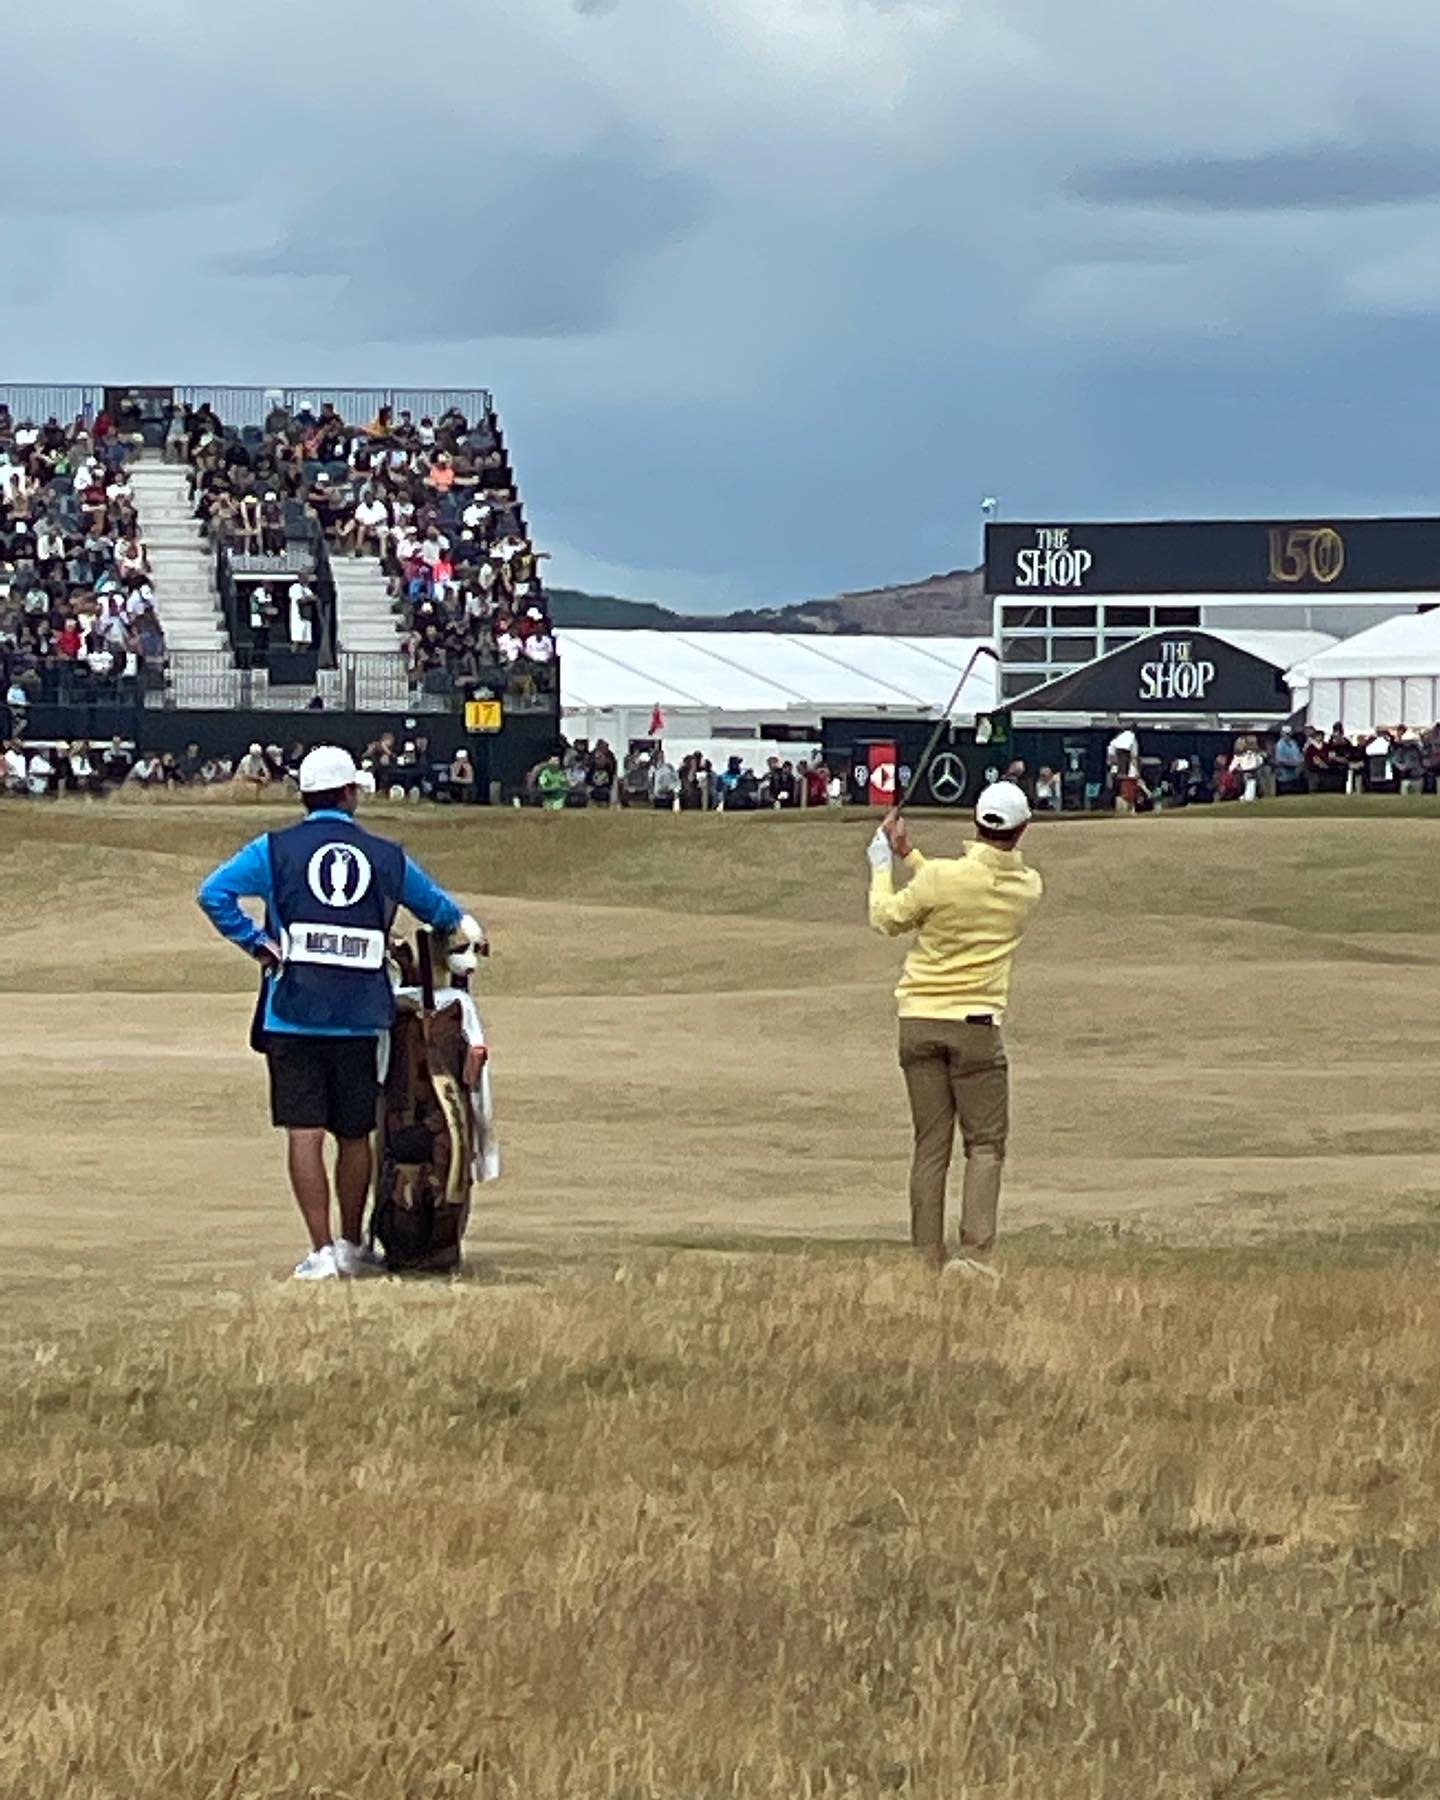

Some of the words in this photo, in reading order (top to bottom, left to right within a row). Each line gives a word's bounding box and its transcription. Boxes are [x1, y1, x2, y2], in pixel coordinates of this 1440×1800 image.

[1036, 528, 1069, 549] THE
[1015, 549, 1092, 587] SHOP
[1268, 528, 1344, 583] 150
[1161, 641, 1192, 662] THE
[1139, 661, 1215, 698] SHOP
[473, 703, 496, 725] 17
